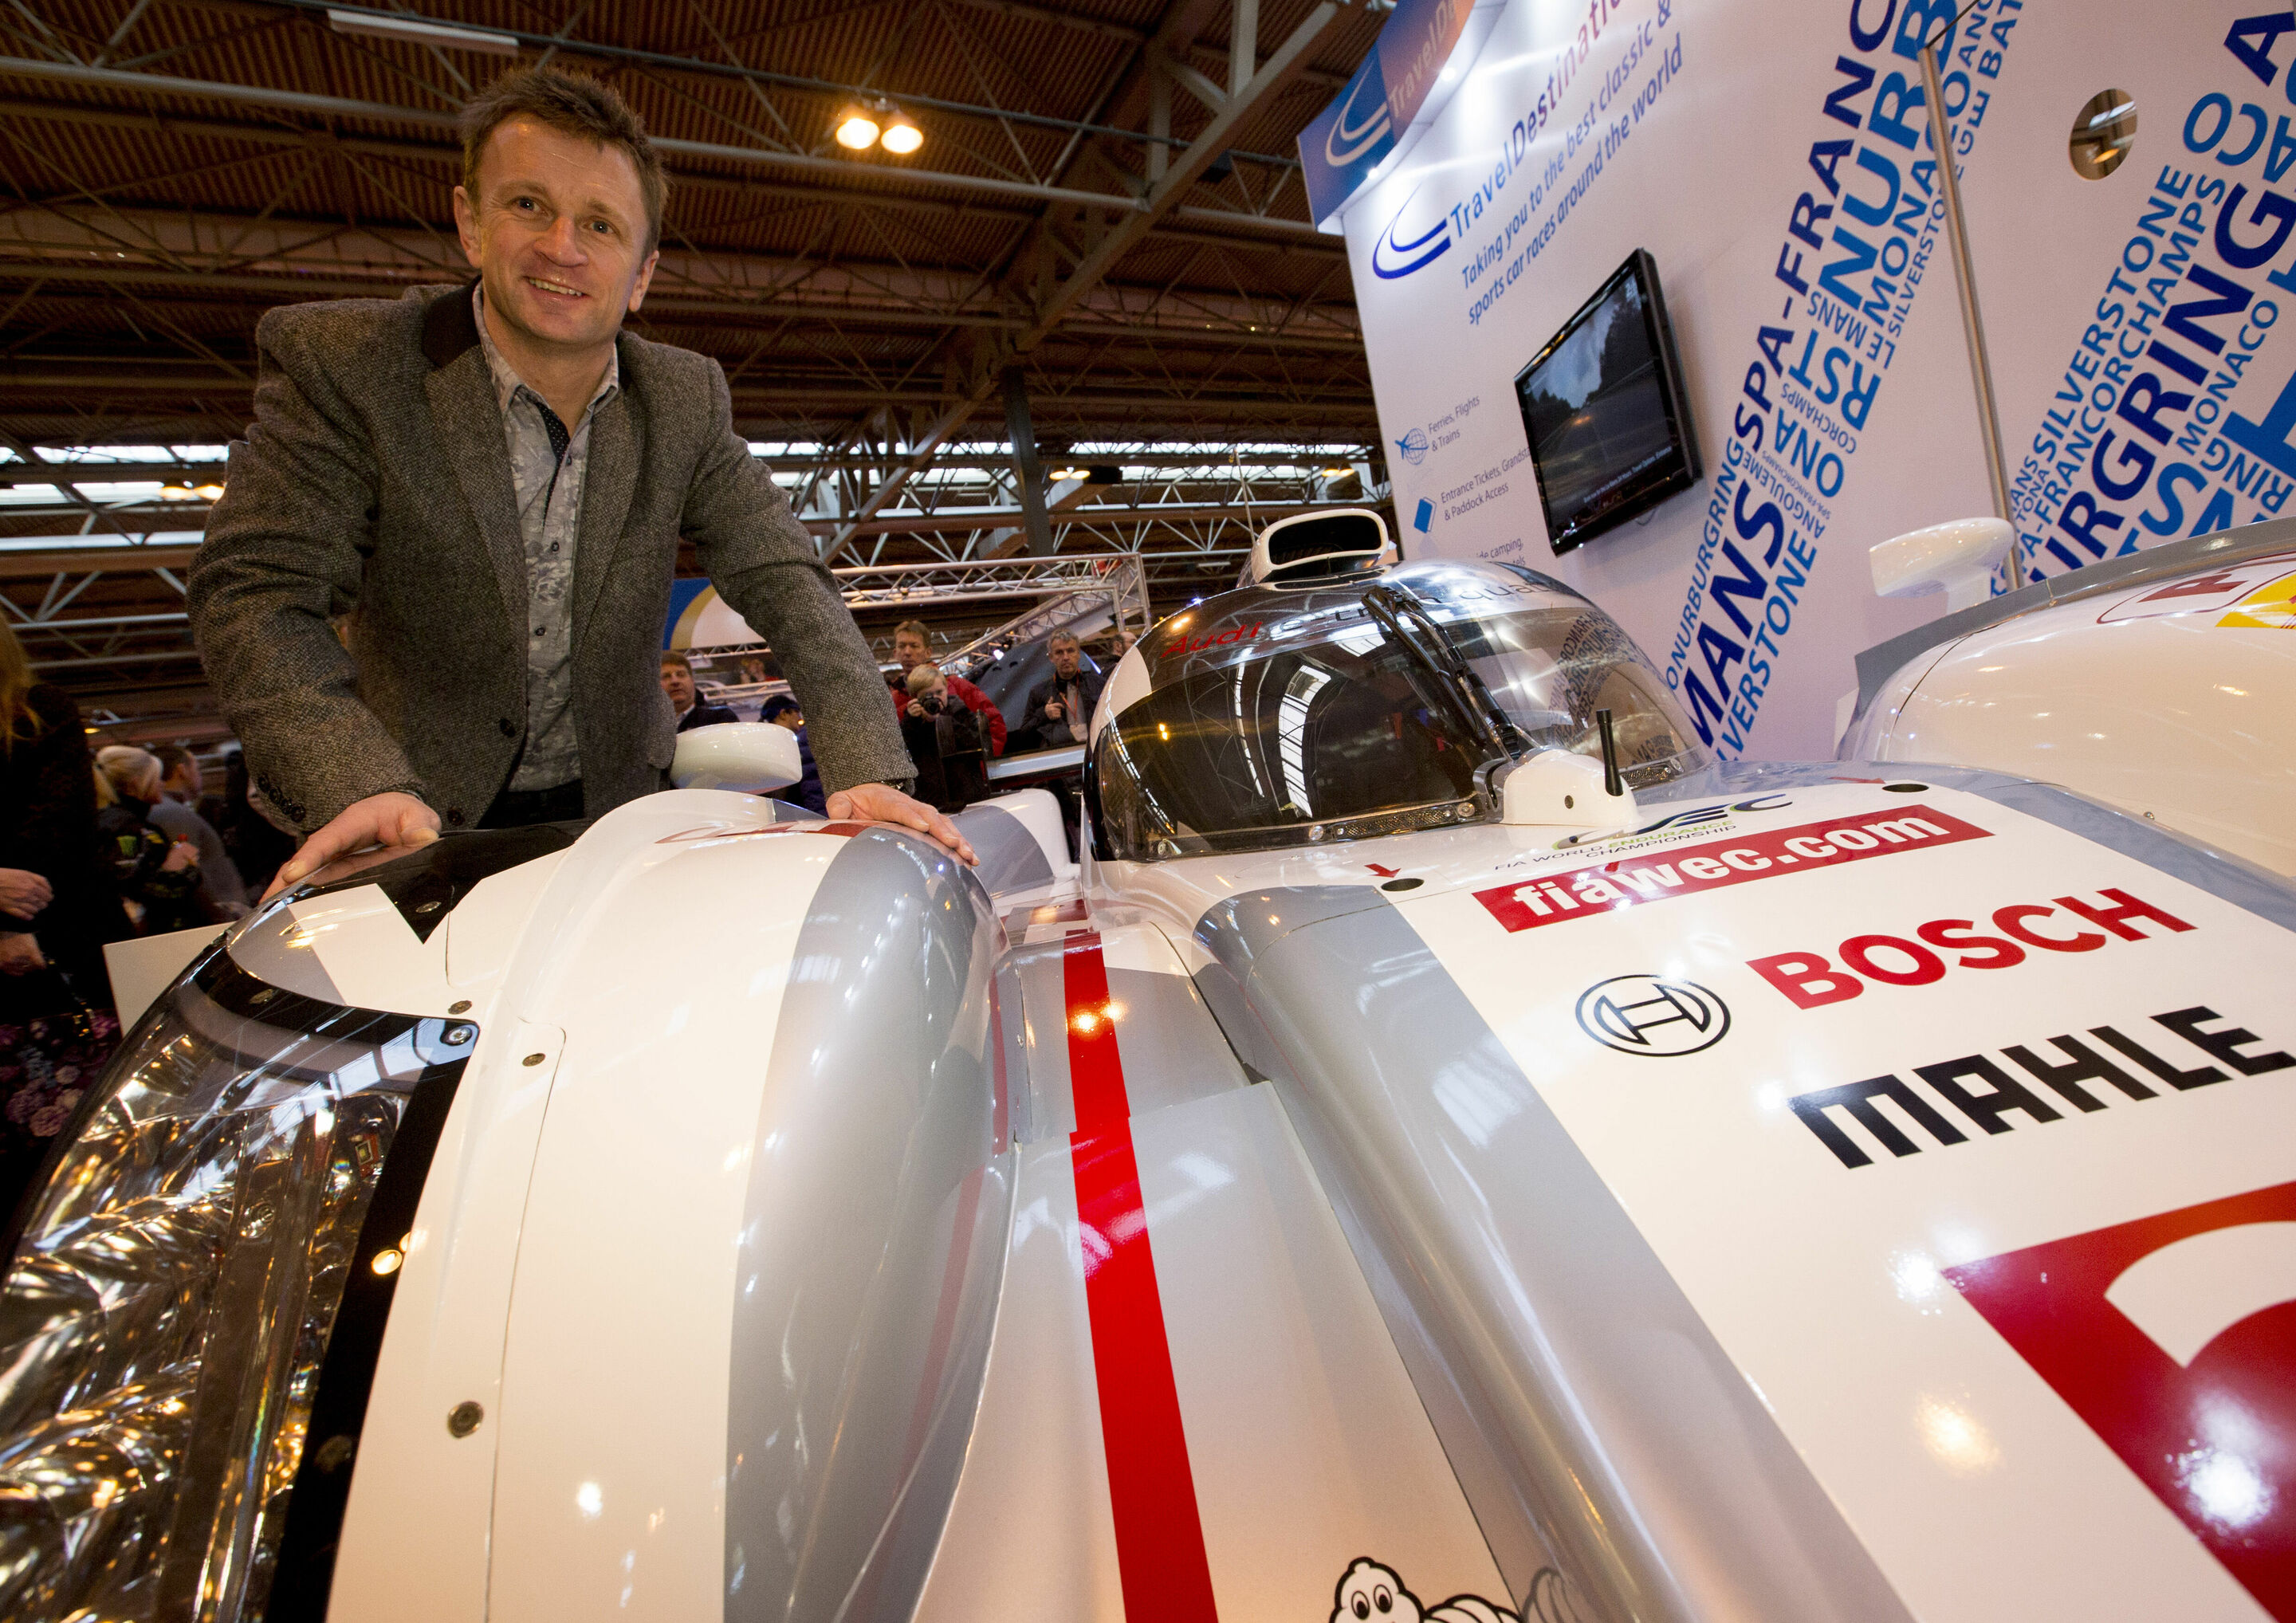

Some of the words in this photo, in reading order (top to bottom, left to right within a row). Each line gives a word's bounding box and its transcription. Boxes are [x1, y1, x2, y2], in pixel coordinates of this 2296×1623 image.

[1449, 0, 1622, 238] TravelDestinati
[1462, 234, 1504, 289] Taking
[1505, 203, 1528, 250] you
[1530, 183, 1543, 212] to
[1544, 151, 1565, 191] the
[1567, 100, 1595, 159] best
[1599, 19, 1653, 112] classic
[1658, 0, 1671, 28] &
[1469, 276, 1505, 325] sports
[1506, 252, 1524, 286] car
[1526, 214, 1556, 265] races
[1558, 140, 1603, 225] around
[1605, 114, 1630, 160] the
[1632, 31, 1683, 124] world
[1888, 164, 1964, 338] SILVERSTO
[1807, 290, 1869, 350] MANS
[2034, 164, 2194, 462] SILVERSTONE
[1866, 331, 1896, 369] LE
[2176, 300, 2278, 455] MONACO
[1428, 413, 1455, 434] Ferries,
[1455, 395, 1480, 419] Flights
[1432, 439, 1438, 452] &
[1438, 429, 1461, 447] Trains
[1780, 382, 1857, 454] CORCHAMPS
[1441, 481, 1474, 504] Entrance
[1474, 466, 1502, 486] Tickets,
[1445, 509, 1450, 521] &
[1451, 493, 1484, 517] Paddock
[1485, 481, 1509, 502] Access
[1740, 450, 1826, 539] ANGOULEME
[1762, 450, 1831, 520] SPA-FRANCORCHAMPS
[2011, 455, 2038, 512] ANS
[2015, 469, 2050, 533] TONA
[2200, 437, 2295, 514] RING
[1160, 621, 1263, 658] Audi
[1684, 480, 1786, 749] MANS
[1494, 860, 1527, 871] FIA
[1531, 846, 1603, 863] WORLD
[1607, 820, 1735, 849] ENDURANCE
[1512, 814, 1951, 917] fiawec.com
[1586, 824, 1737, 859] CHAMPIONSHIP
[1744, 887, 2199, 1010] BOSCH
[1787, 1005, 2296, 1169] MAHLE
